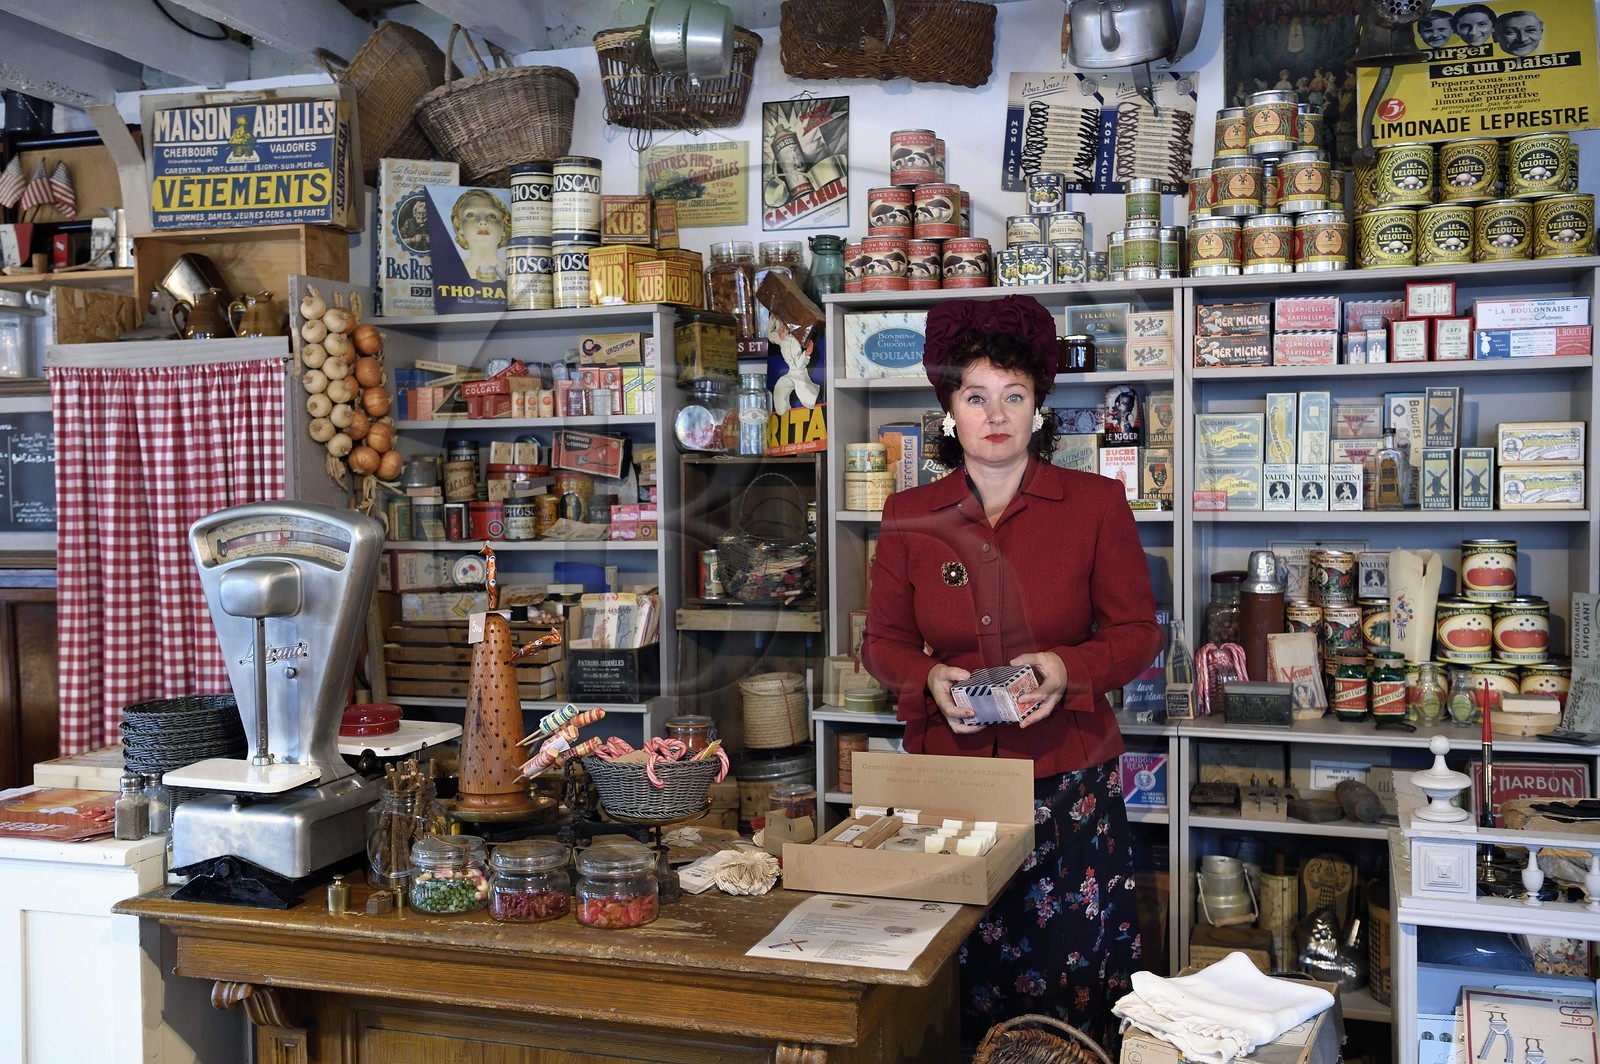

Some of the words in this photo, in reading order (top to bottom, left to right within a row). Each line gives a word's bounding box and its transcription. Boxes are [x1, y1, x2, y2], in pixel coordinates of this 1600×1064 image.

[1442, 63, 1469, 75] est
[1473, 61, 1499, 73] un
[1503, 54, 1570, 72] plaisir
[1431, 80, 1475, 90] Préparez
[1443, 80, 1526, 93] instantanément
[1468, 87, 1526, 97] excellente
[1435, 97, 1482, 105] limonade
[1486, 92, 1539, 103] purgative
[154, 107, 231, 142] MAISON
[253, 100, 335, 138] ABEILLES
[1371, 116, 1470, 139] LIMONADE
[1481, 106, 1589, 131] LEPRESTRE
[163, 147, 218, 158] CHERBOURG
[270, 142, 317, 153] VALOGNES
[1513, 141, 1550, 168] CHAMPIGNONS
[1385, 152, 1422, 176] CHAMPIGNONS
[159, 173, 327, 208] VÊTEMENTS
[553, 174, 600, 193] OSCAO
[158, 214, 174, 222] POUR
[234, 211, 264, 219] JEUNES
[265, 210, 285, 219] GENS
[293, 208, 326, 217] ENFANTS
[606, 203, 646, 212] BOUILLON
[606, 213, 646, 234] KUB
[1480, 209, 1517, 235] CHAMPIGNONS
[1540, 203, 1579, 231] CHAMPIGNONS
[1370, 217, 1406, 240] CHAMPIGNONS
[1427, 213, 1463, 238] CHAMPIGNONS
[590, 254, 624, 265] BOUILLON
[636, 268, 663, 276] BOUILLON
[667, 269, 690, 277] BOUILLON
[636, 275, 664, 302] KUB
[667, 275, 690, 302] KUB
[1511, 305, 1571, 314] BOULONNAISE
[877, 340, 916, 348] CHOCOLAT
[872, 351, 923, 360] POULAIN
[465, 386, 501, 395] COLGATE
[1409, 400, 1421, 439] BOUGIES
[1114, 432, 1138, 440] NIGER
[1149, 434, 1173, 442] BANAN
[1582, 602, 1590, 659] L'AFFOLANT
[1137, 683, 1154, 692] lave
[1126, 693, 1143, 704] plus
[1124, 756, 1153, 764] AMIDON
[1492, 774, 1575, 797] CHARBON
[909, 867, 973, 886] Avant
